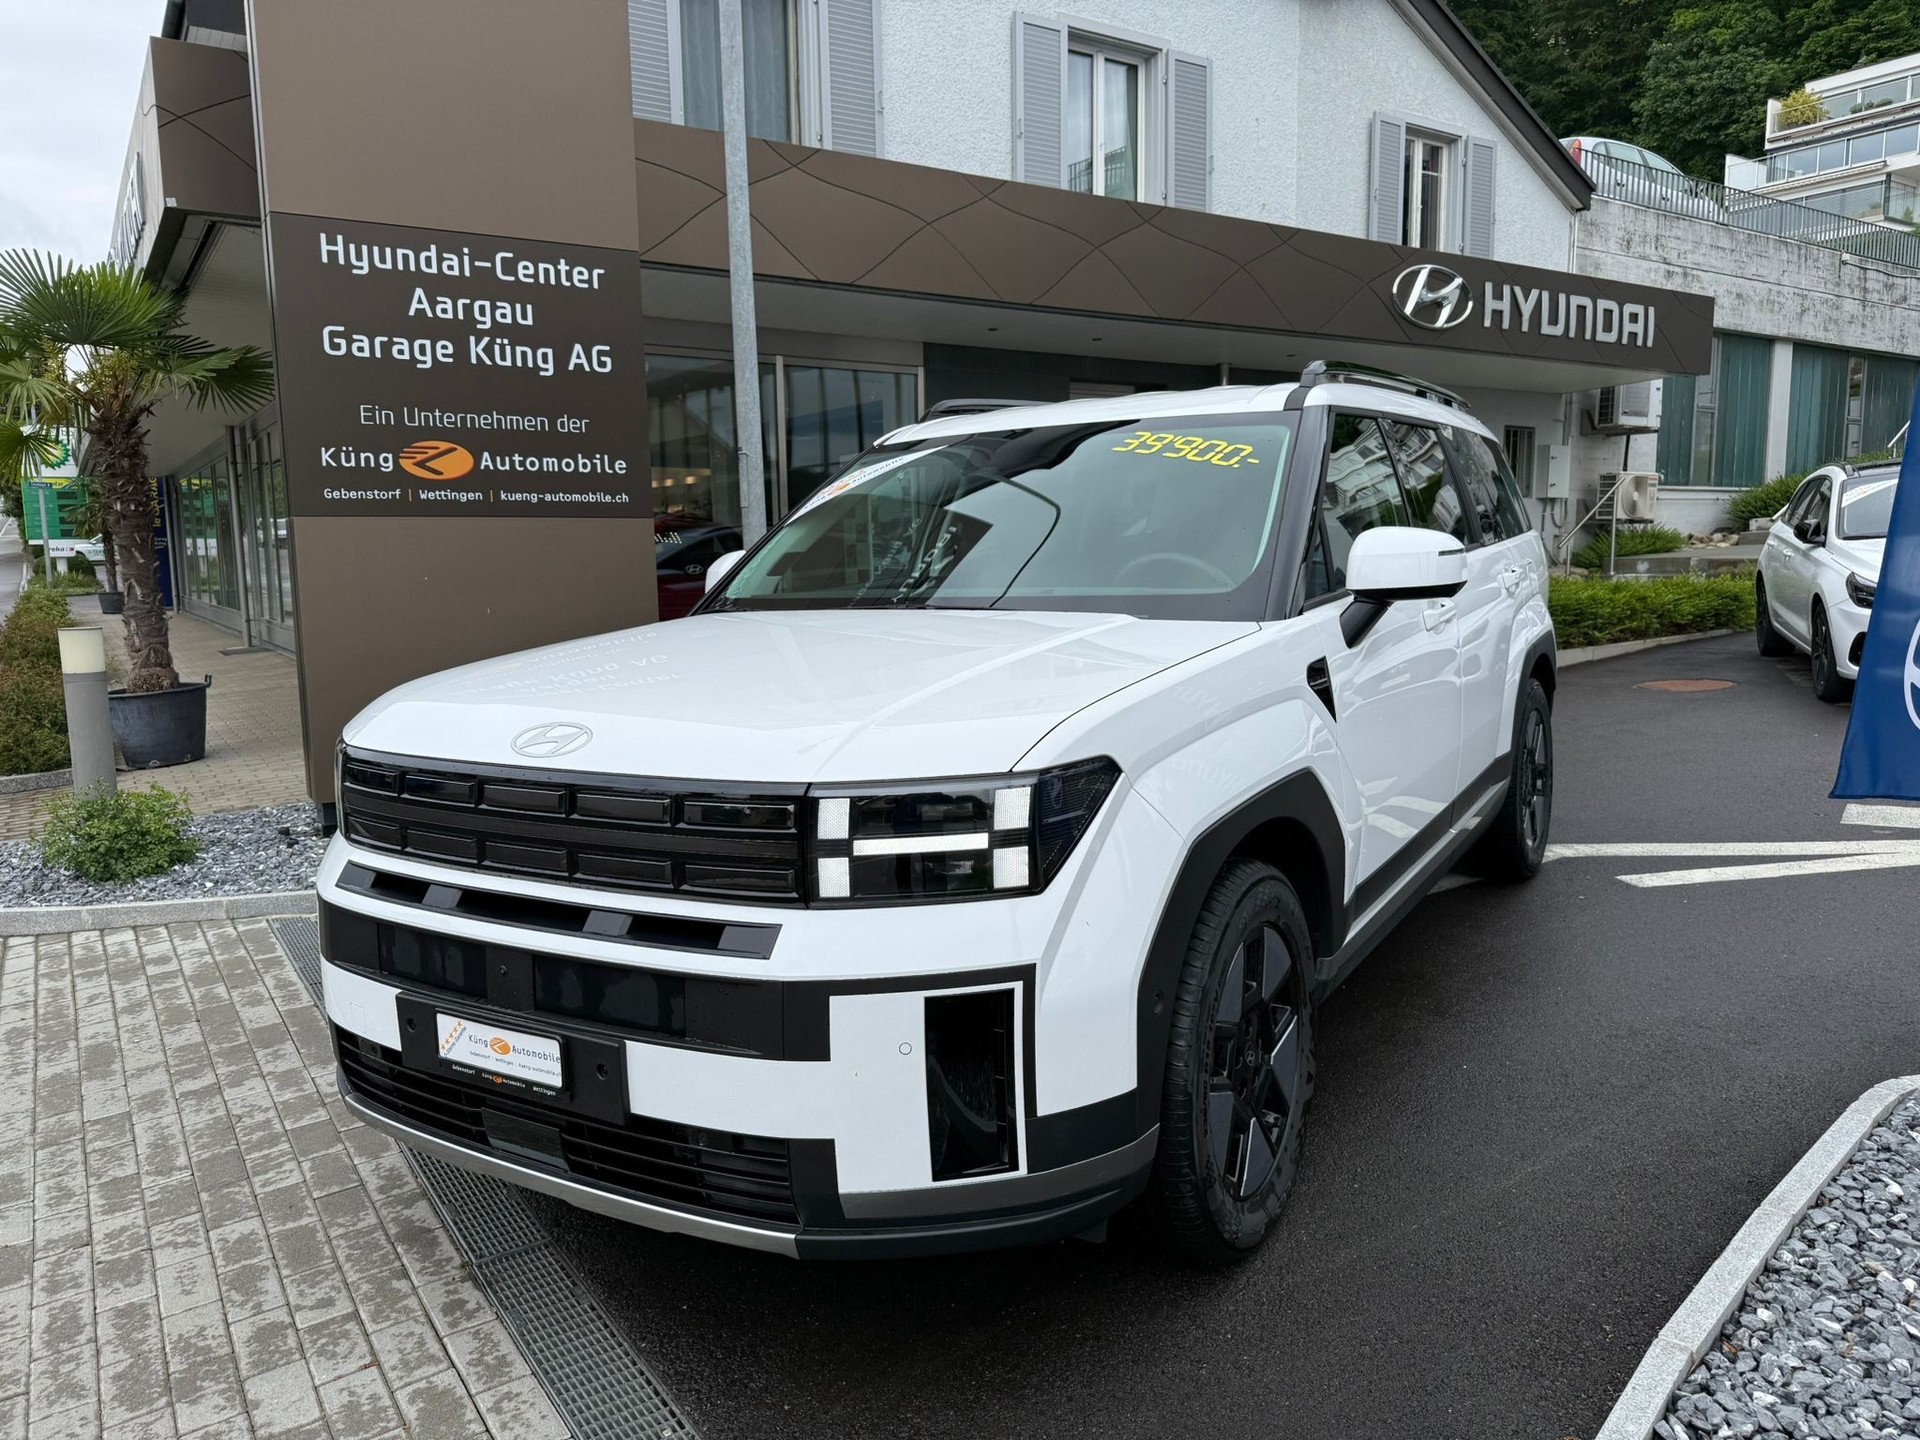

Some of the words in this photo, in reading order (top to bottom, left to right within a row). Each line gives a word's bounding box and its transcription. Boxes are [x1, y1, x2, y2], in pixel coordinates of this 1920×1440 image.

[319, 232, 605, 289] Hyundai-Center
[408, 287, 534, 329] Aargau
[1483, 280, 1656, 348] HYUNDAI
[322, 325, 454, 369] Garage
[469, 335, 554, 376] Küng
[567, 343, 613, 373] AG
[359, 404, 395, 426] Ein
[403, 406, 549, 432] Unternehmen
[556, 414, 590, 433] der
[320, 446, 394, 473] Küng
[480, 451, 628, 475] Automobile
[323, 488, 402, 500] Gebenstorf
[419, 489, 483, 503] Wettingen
[500, 490, 630, 503] kueng-automobile.ch
[468, 1033, 489, 1048] Küng
[512, 1045, 561, 1064] Automobile
